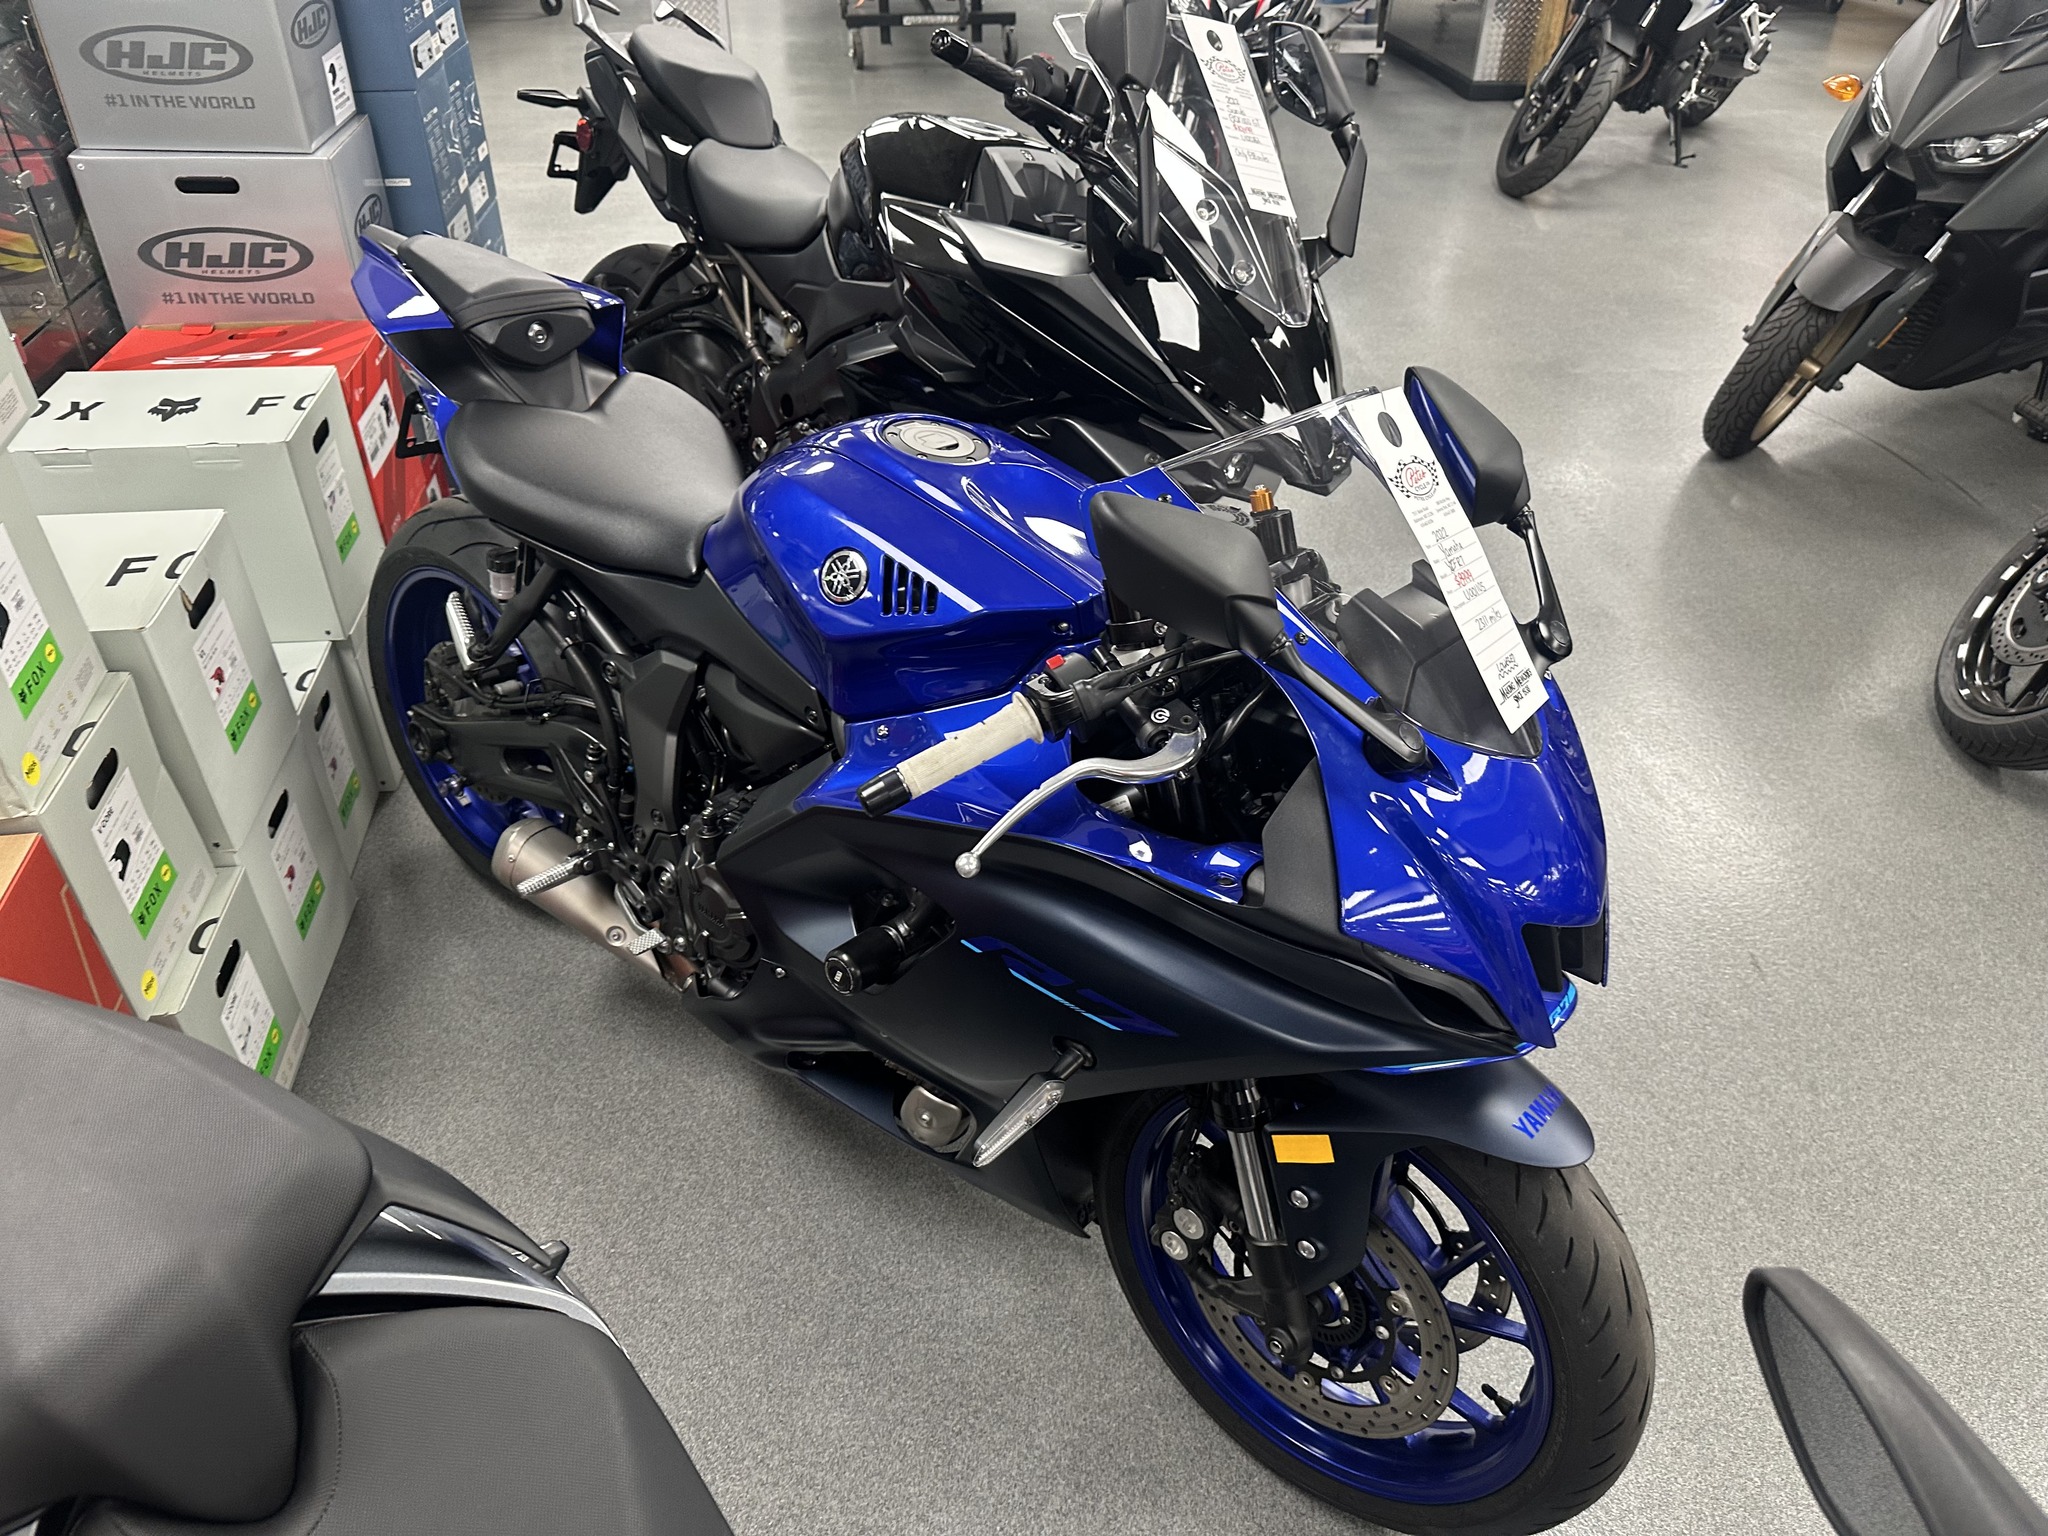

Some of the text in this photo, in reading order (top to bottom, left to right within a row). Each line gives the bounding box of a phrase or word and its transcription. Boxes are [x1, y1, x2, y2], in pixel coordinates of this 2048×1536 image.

[297, 5, 327, 44] HJC
[106, 40, 227, 70] HJC
[105, 93, 255, 110] #1 IN THE WORLD
[164, 242, 288, 268] HJC
[162, 292, 315, 305] #1 IN THE WORLD
[1432, 526, 1449, 542] 2022
[26, 660, 47, 695] FOX
[143, 882, 163, 914] FOX
[1512, 1084, 1563, 1139] YAMAH
